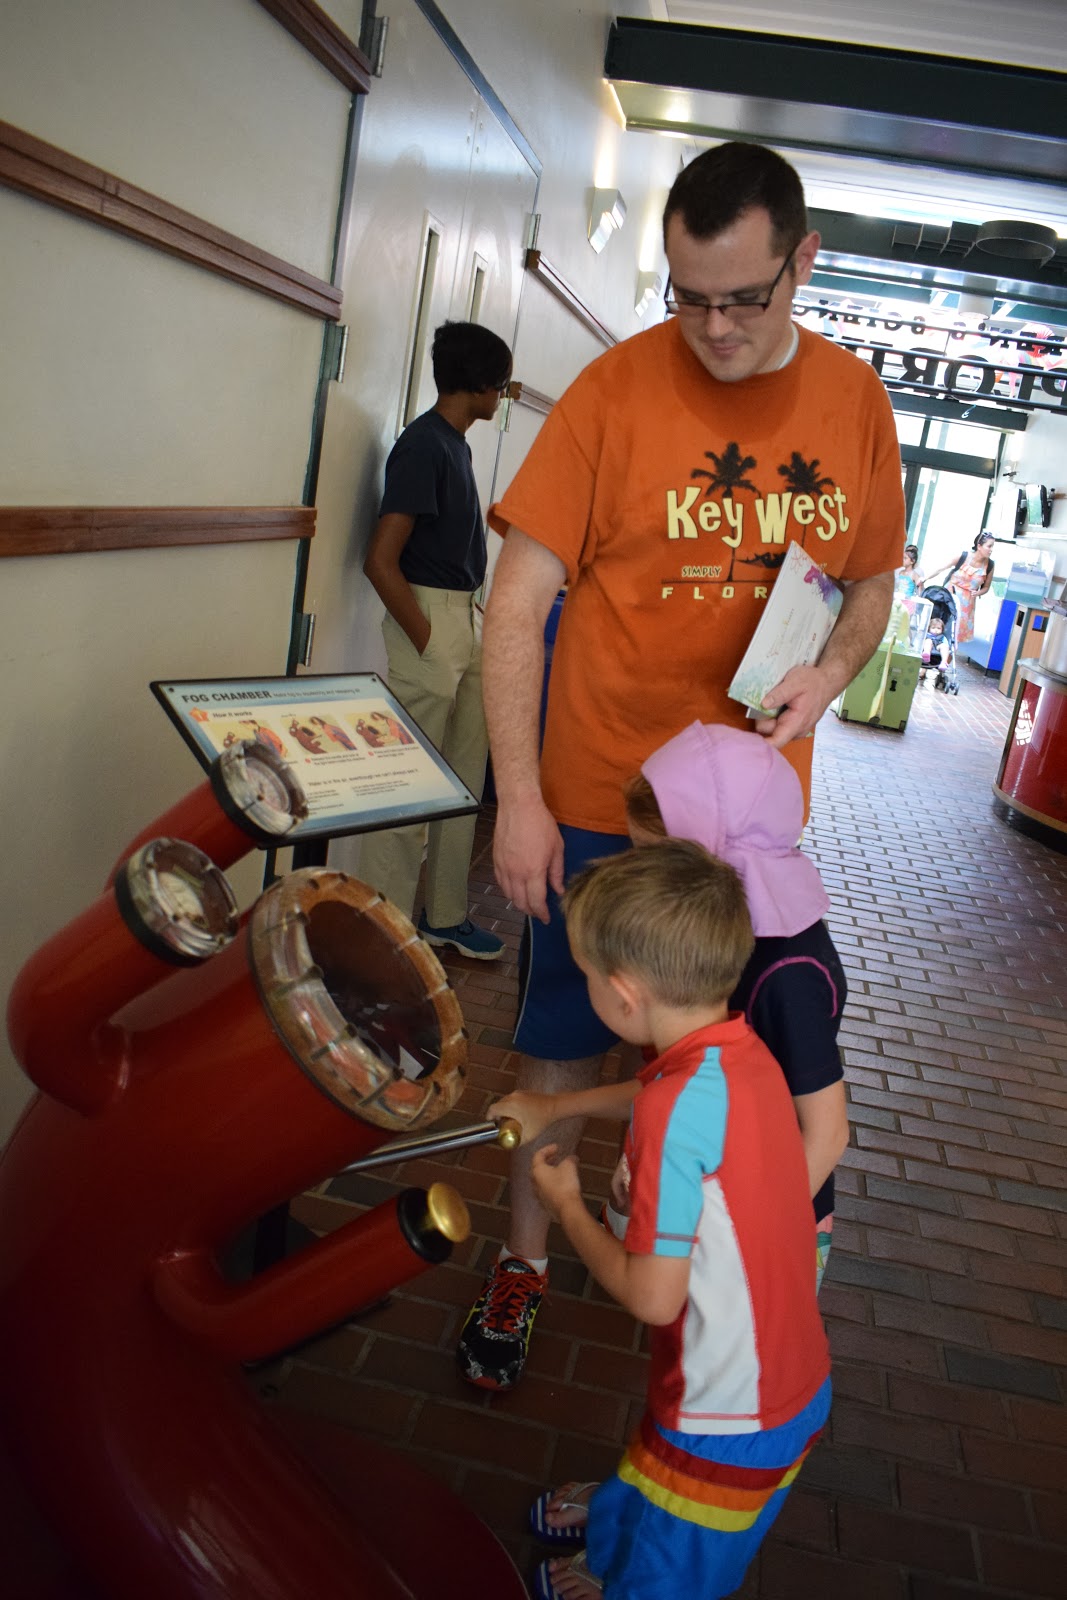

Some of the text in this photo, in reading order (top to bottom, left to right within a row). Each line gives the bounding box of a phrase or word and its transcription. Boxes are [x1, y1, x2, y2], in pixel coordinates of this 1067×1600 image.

[666, 486, 850, 548] Key West
[681, 566, 722, 577] SIMPLY
[661, 586, 767, 599] FLOR
[181, 690, 272, 703] FOG CHAMBER
